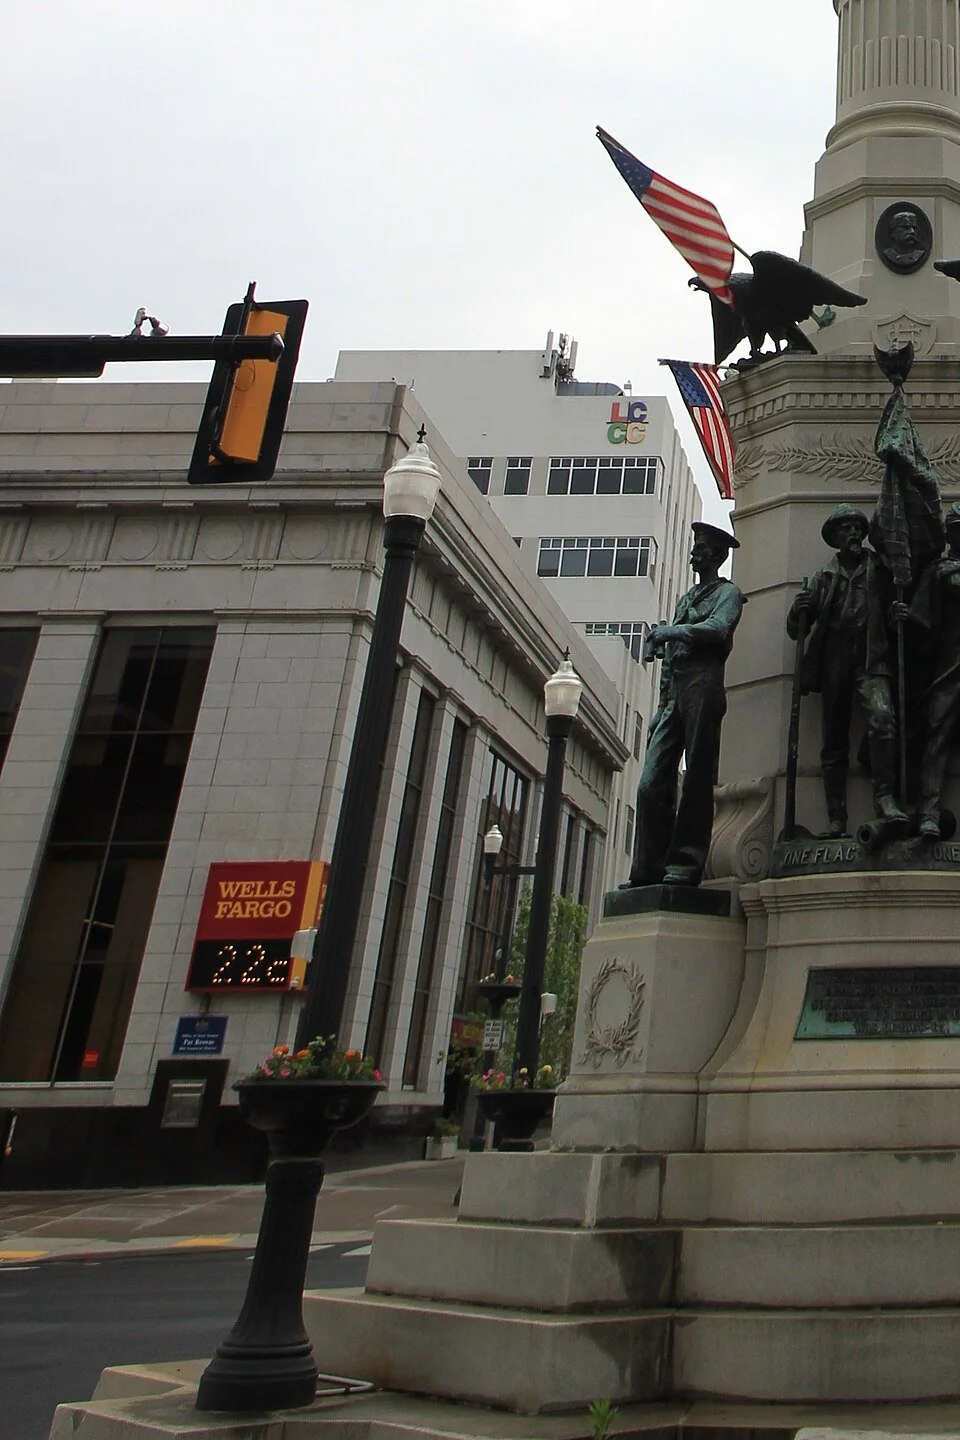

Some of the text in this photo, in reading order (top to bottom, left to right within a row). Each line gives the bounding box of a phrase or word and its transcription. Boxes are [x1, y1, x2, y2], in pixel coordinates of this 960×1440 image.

[784, 848, 810, 865] ONE
[933, 845, 960, 862] ONE
[219, 880, 296, 899] WELLS
[215, 900, 292, 919] FARGO
